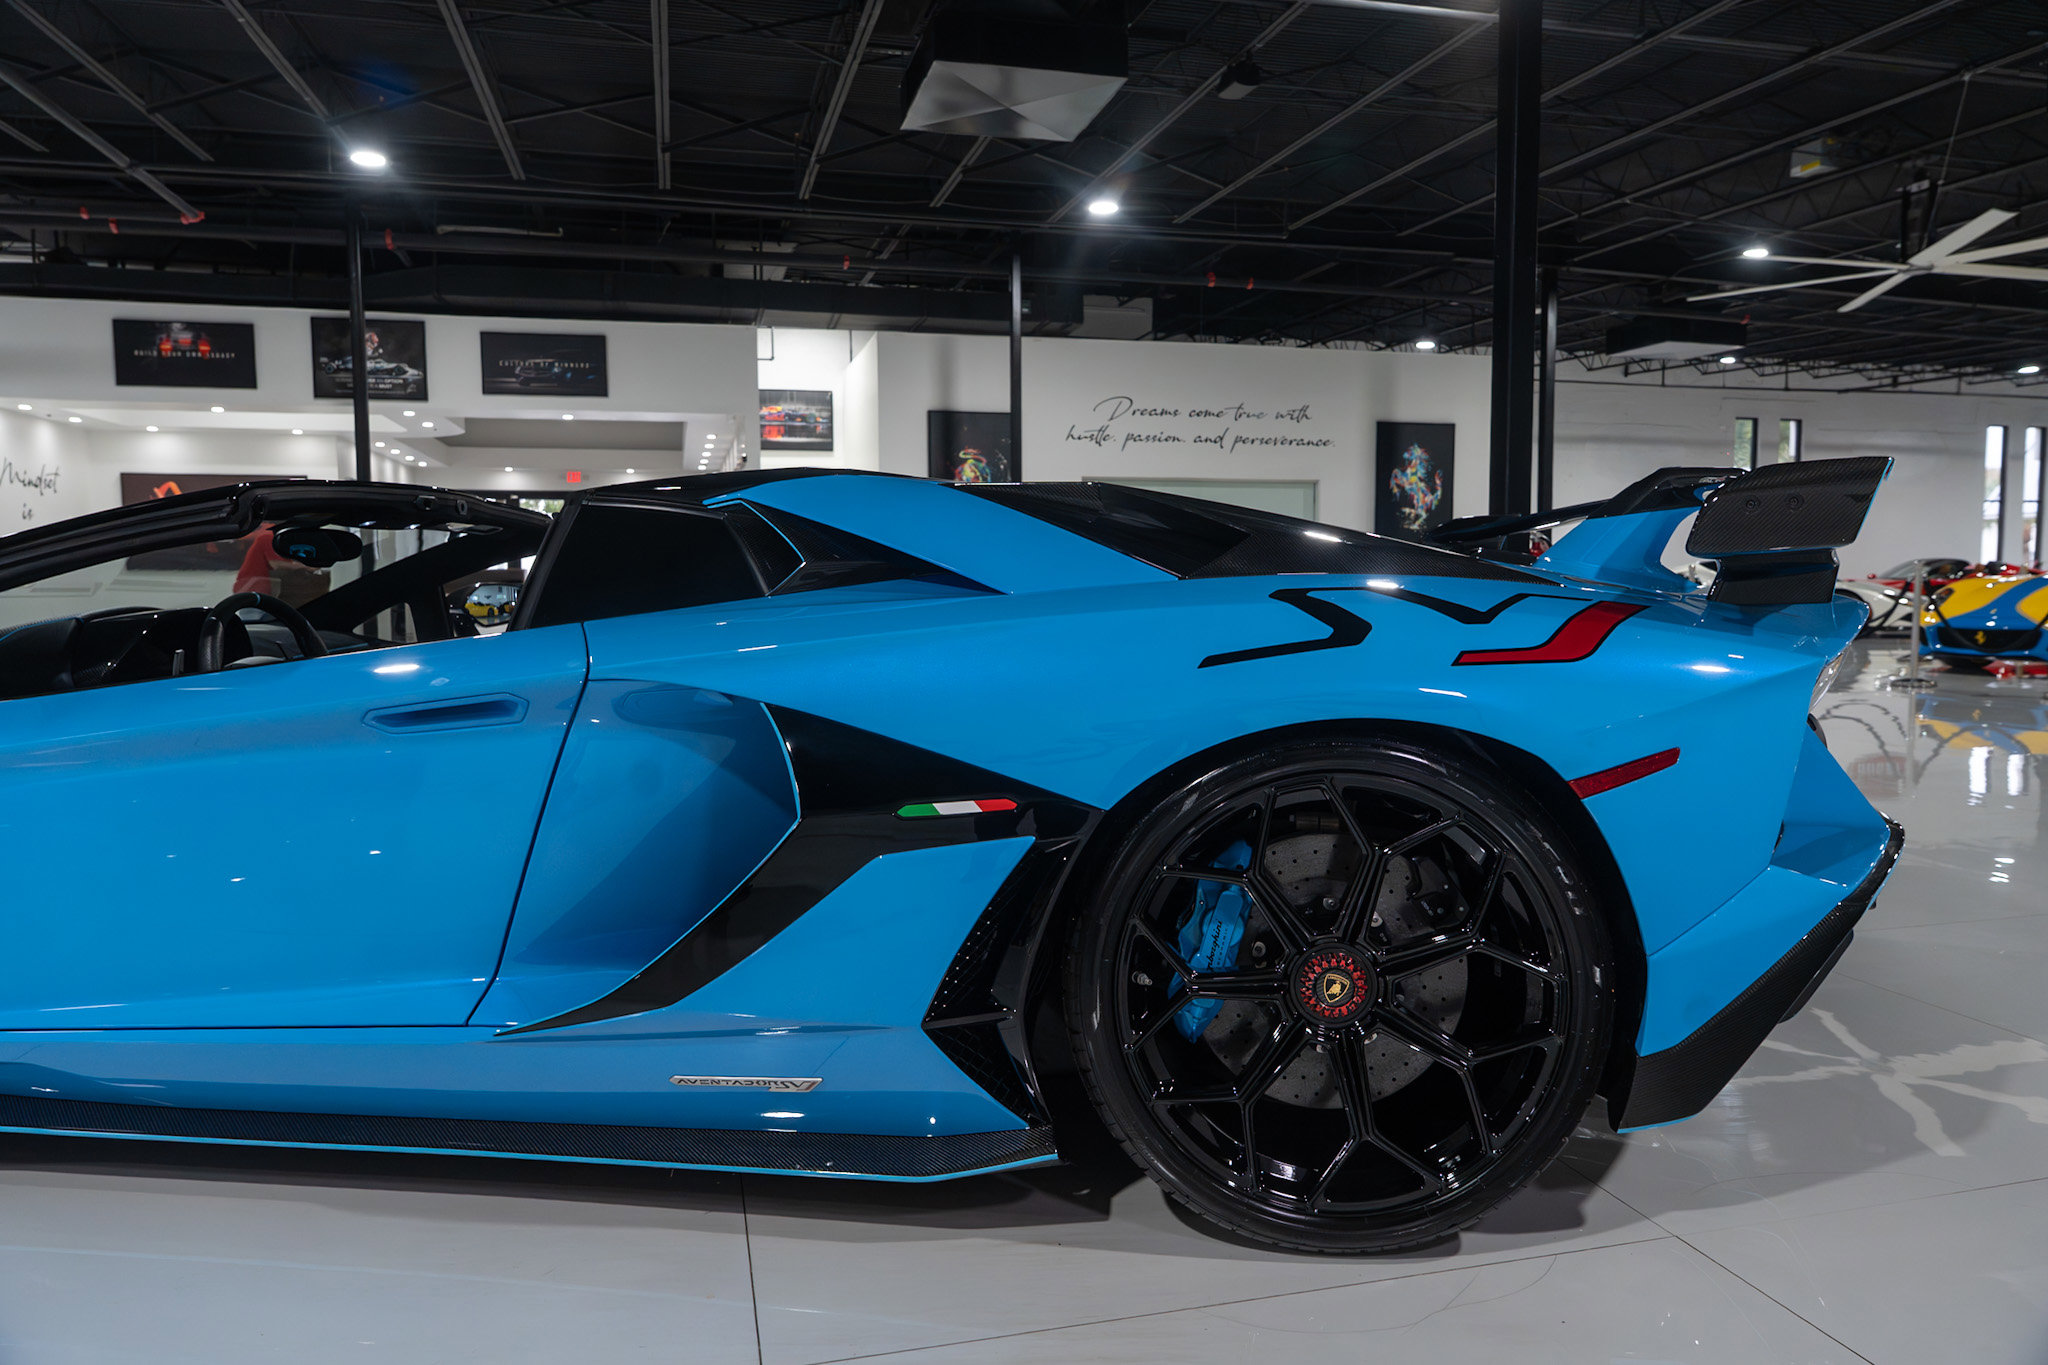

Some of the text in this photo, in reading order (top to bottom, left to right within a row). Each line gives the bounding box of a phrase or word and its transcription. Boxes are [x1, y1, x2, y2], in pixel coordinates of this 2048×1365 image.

[1093, 395, 1313, 424] Dreams come true with
[1193, 427, 1231, 450] and
[0, 456, 61, 496] Mindset
[22, 502, 33, 521] is
[1206, 919, 1222, 971] mborghini
